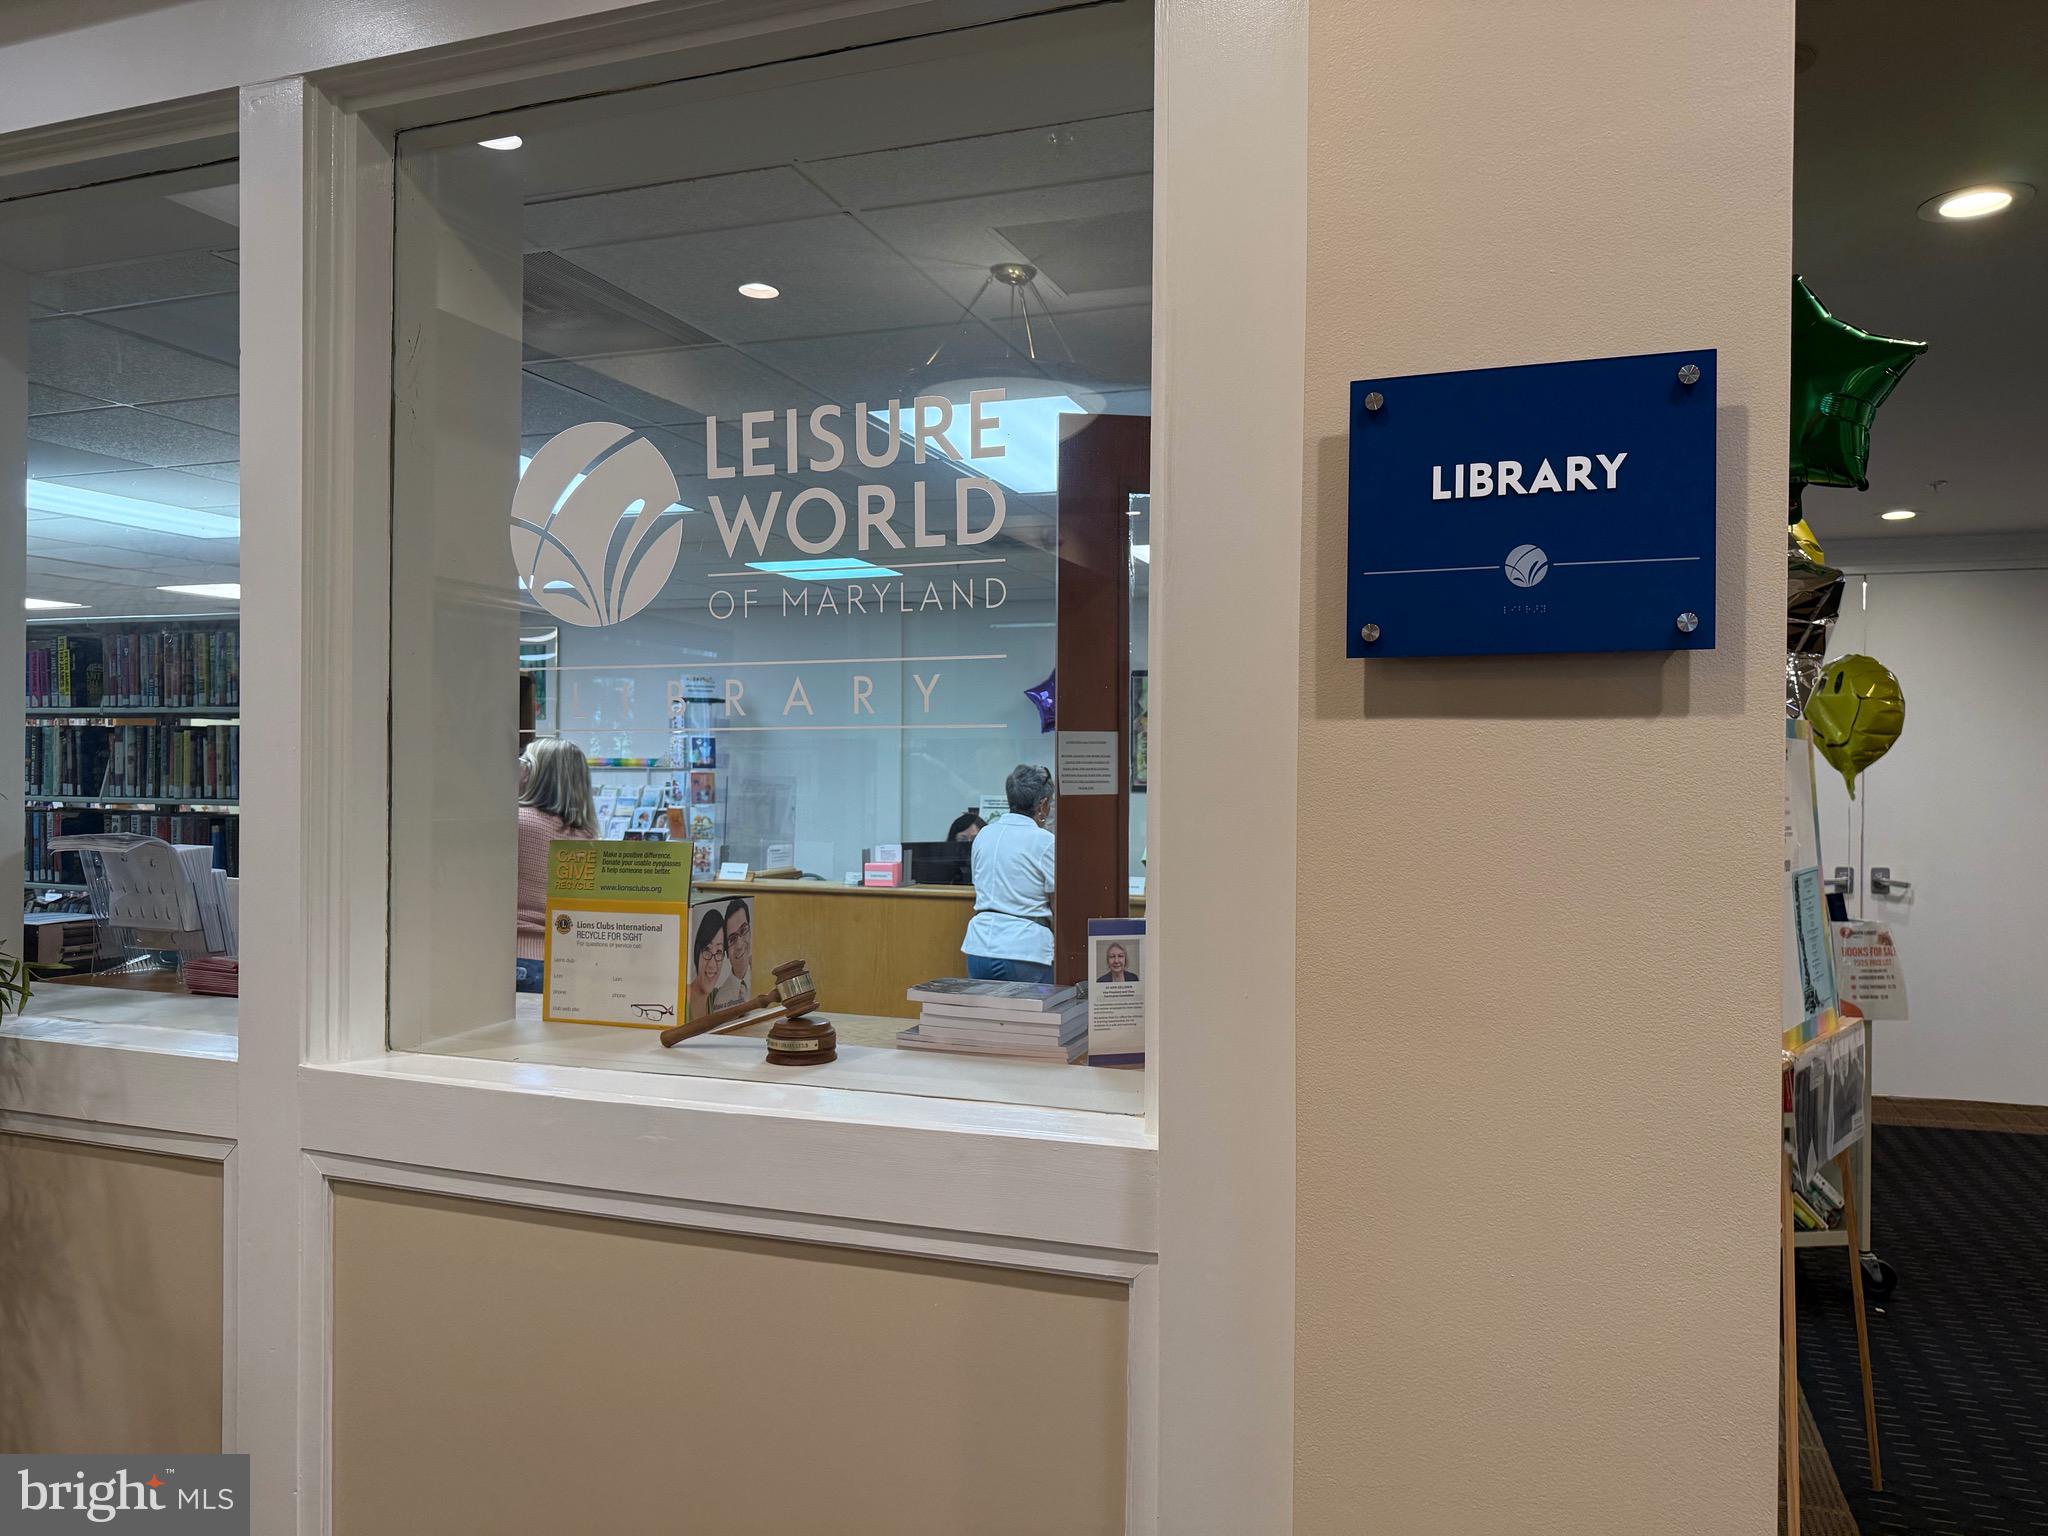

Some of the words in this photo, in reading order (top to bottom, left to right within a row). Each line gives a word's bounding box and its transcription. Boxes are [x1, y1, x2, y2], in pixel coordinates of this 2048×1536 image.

[706, 388, 1007, 480] LEISURE
[1432, 452, 1628, 502] LIBRARY
[708, 478, 1007, 559] WORLD
[708, 588, 758, 621] OF
[783, 577, 1007, 618] MARYLAND
[557, 849, 597, 864] CARE
[634, 859, 651, 867] usable
[653, 860, 681, 868] eyeglasses
[557, 864, 595, 880] GIVE
[555, 881, 595, 891] RECYCLE
[600, 883, 662, 893] www.lionsclubs.org
[577, 921, 594, 930] Lions
[596, 922, 614, 931] Clubs
[616, 923, 662, 932] International
[577, 931, 606, 940] RECYCLE
[608, 932, 620, 941] FOR
[623, 933, 643, 942] SIGHT
